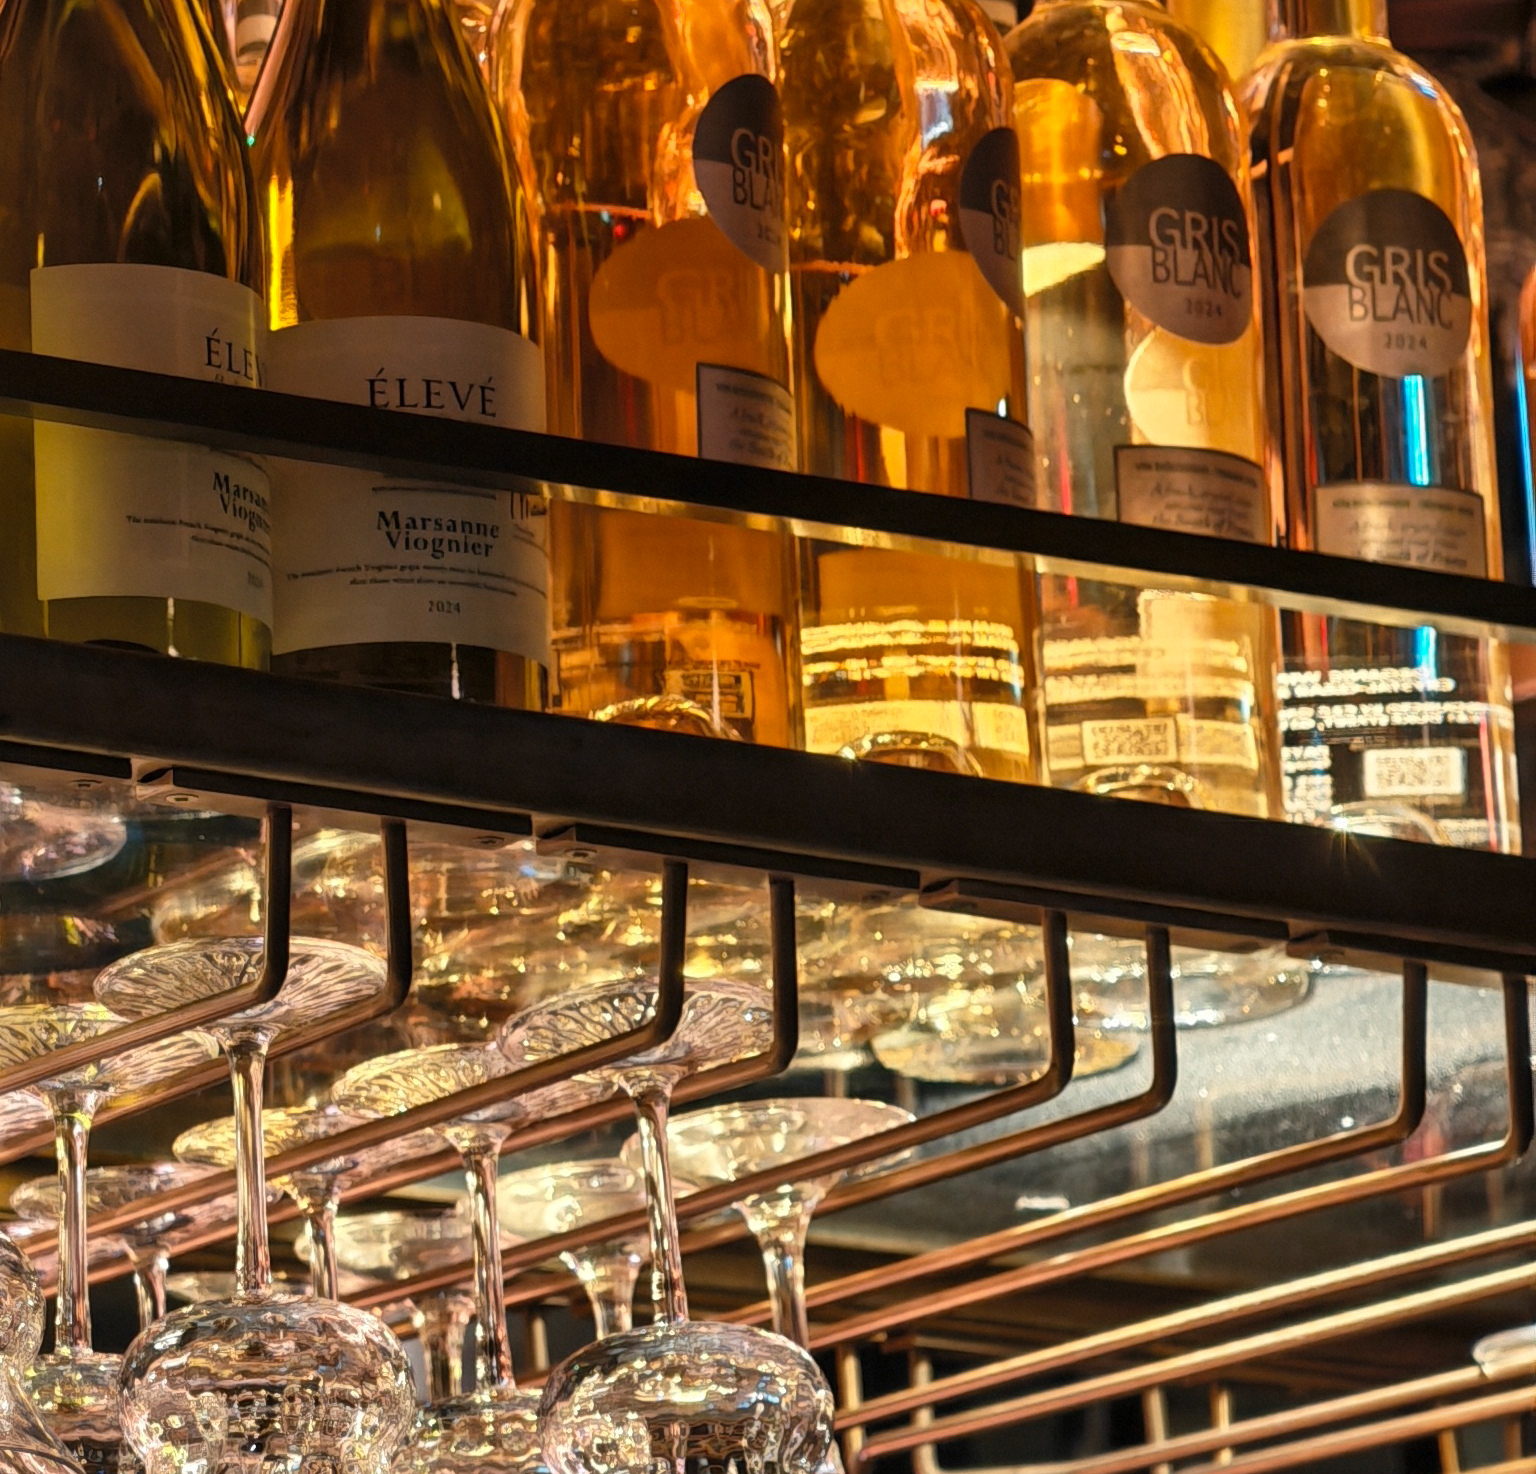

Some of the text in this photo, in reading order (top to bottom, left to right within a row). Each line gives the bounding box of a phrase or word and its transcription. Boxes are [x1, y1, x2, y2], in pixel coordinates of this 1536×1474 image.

[731, 127, 782, 181] GRI
[1148, 206, 1241, 266] GRIS
[1150, 242, 1243, 299] BLANC
[1345, 243, 1451, 294] GRIS
[1347, 281, 1454, 330] BLANC
[204, 327, 268, 388] ÉLEV
[1382, 330, 1429, 352] 2024
[366, 366, 498, 419] ÉLEVÉ
[376, 510, 500, 539] Marsanne
[384, 530, 493, 560] Viognier
[427, 600, 462, 615] 2024
